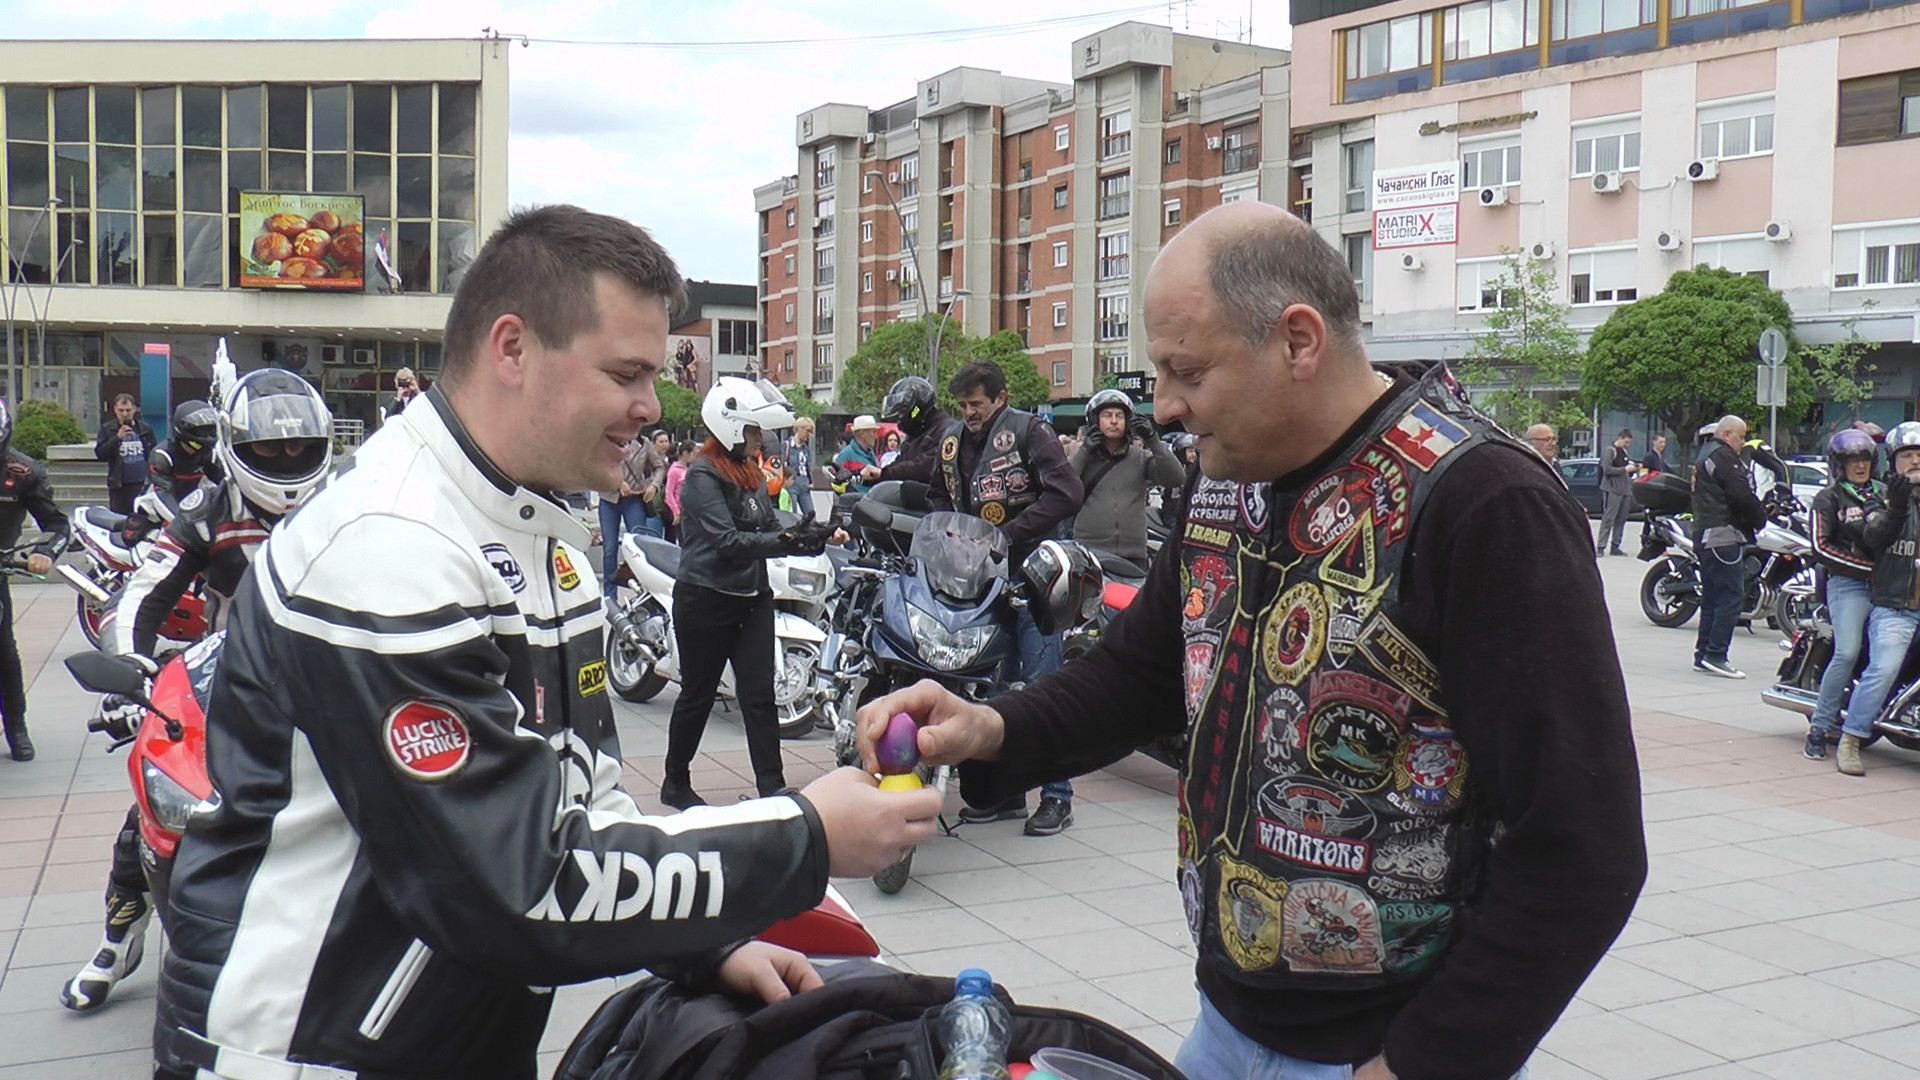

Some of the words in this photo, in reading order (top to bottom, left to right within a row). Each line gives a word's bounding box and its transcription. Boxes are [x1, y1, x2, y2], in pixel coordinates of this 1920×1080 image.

[1430, 171, 1455, 188] Глас
[1378, 226, 1418, 240] STUDIO
[392, 717, 456, 747] LUCKY
[1314, 705, 1398, 743] SHARK
[1340, 723, 1367, 741] MK
[400, 732, 466, 764] STRIKE
[1390, 816, 1451, 837] TOPOA
[1259, 821, 1365, 871] WARRIORS
[524, 848, 725, 923] LUCKY
[1234, 865, 1269, 890] ROAD
[1367, 875, 1446, 900] OPLENAC
